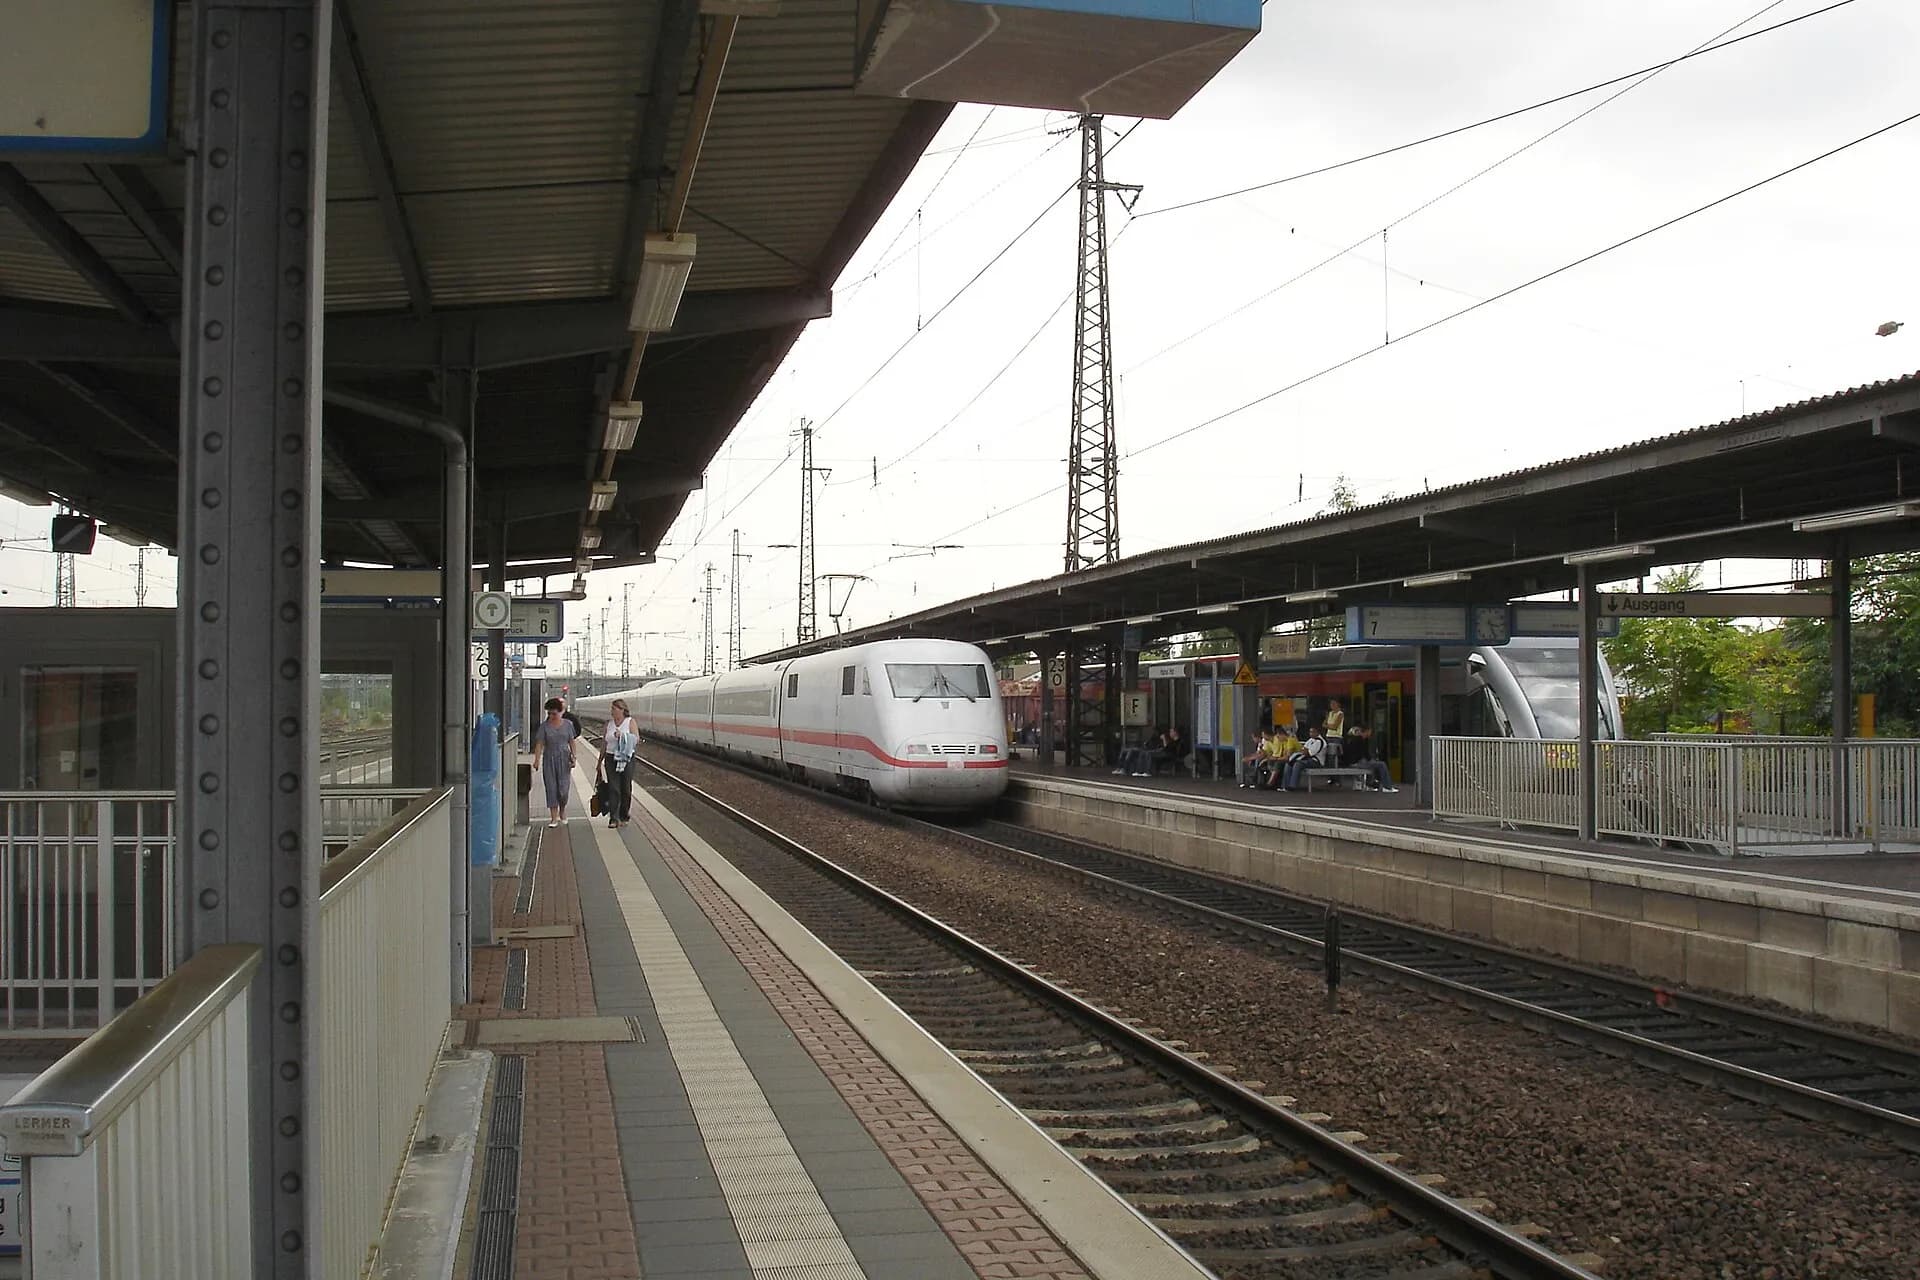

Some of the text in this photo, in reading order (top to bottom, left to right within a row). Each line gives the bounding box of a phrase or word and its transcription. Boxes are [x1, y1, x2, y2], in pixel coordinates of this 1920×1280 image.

[1622, 599, 1686, 613] Ausgang
[540, 619, 548, 634] 6
[1371, 621, 1378, 636] 7
[1049, 659, 1065, 673] 23
[1132, 698, 1140, 714] F
[15, 1117, 71, 1129] LERMER
